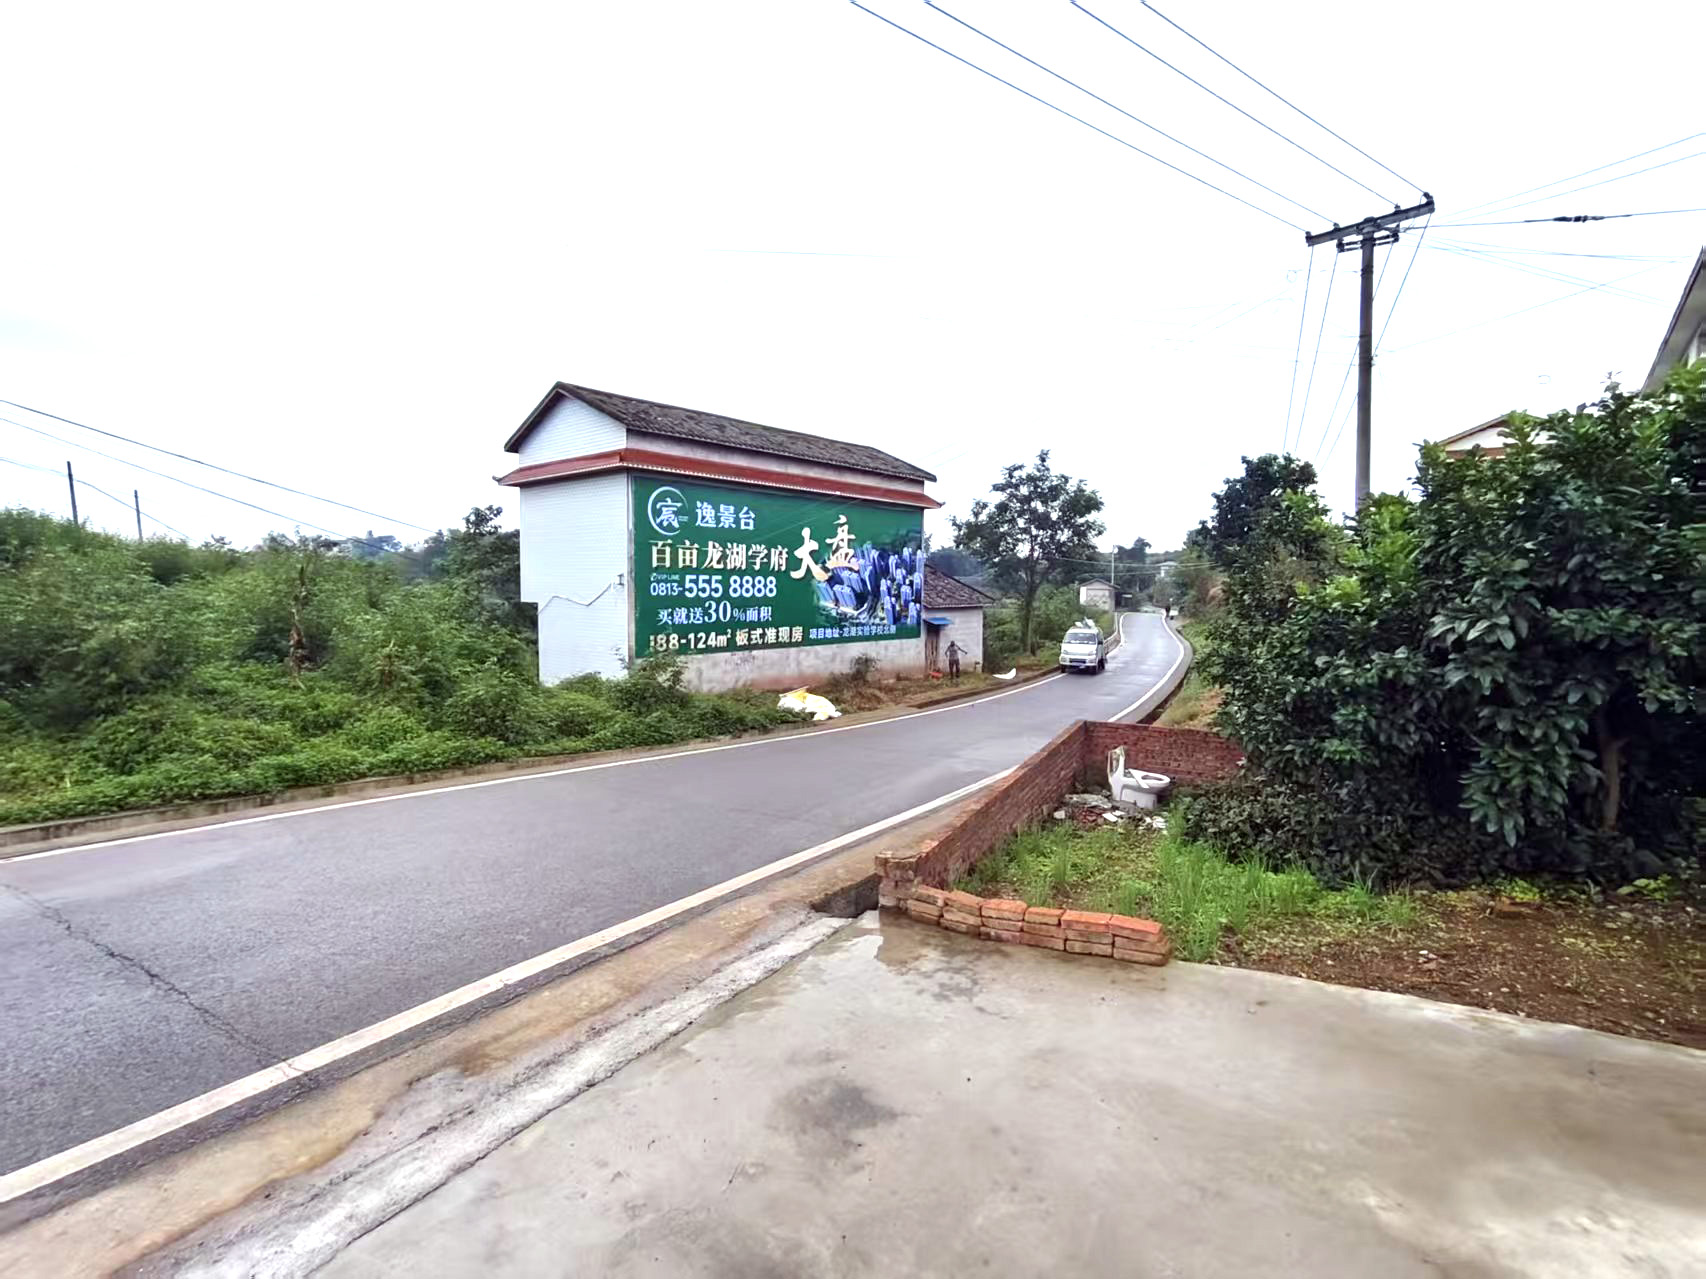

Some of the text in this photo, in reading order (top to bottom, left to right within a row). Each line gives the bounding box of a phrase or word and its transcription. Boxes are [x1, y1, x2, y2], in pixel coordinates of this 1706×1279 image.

[695, 500, 756, 530] 逸景台
[649, 515, 859, 582] 百亩龙湖学府 大盘
[729, 575, 777, 597] 8888
[735, 626, 804, 646] 板式准现房
